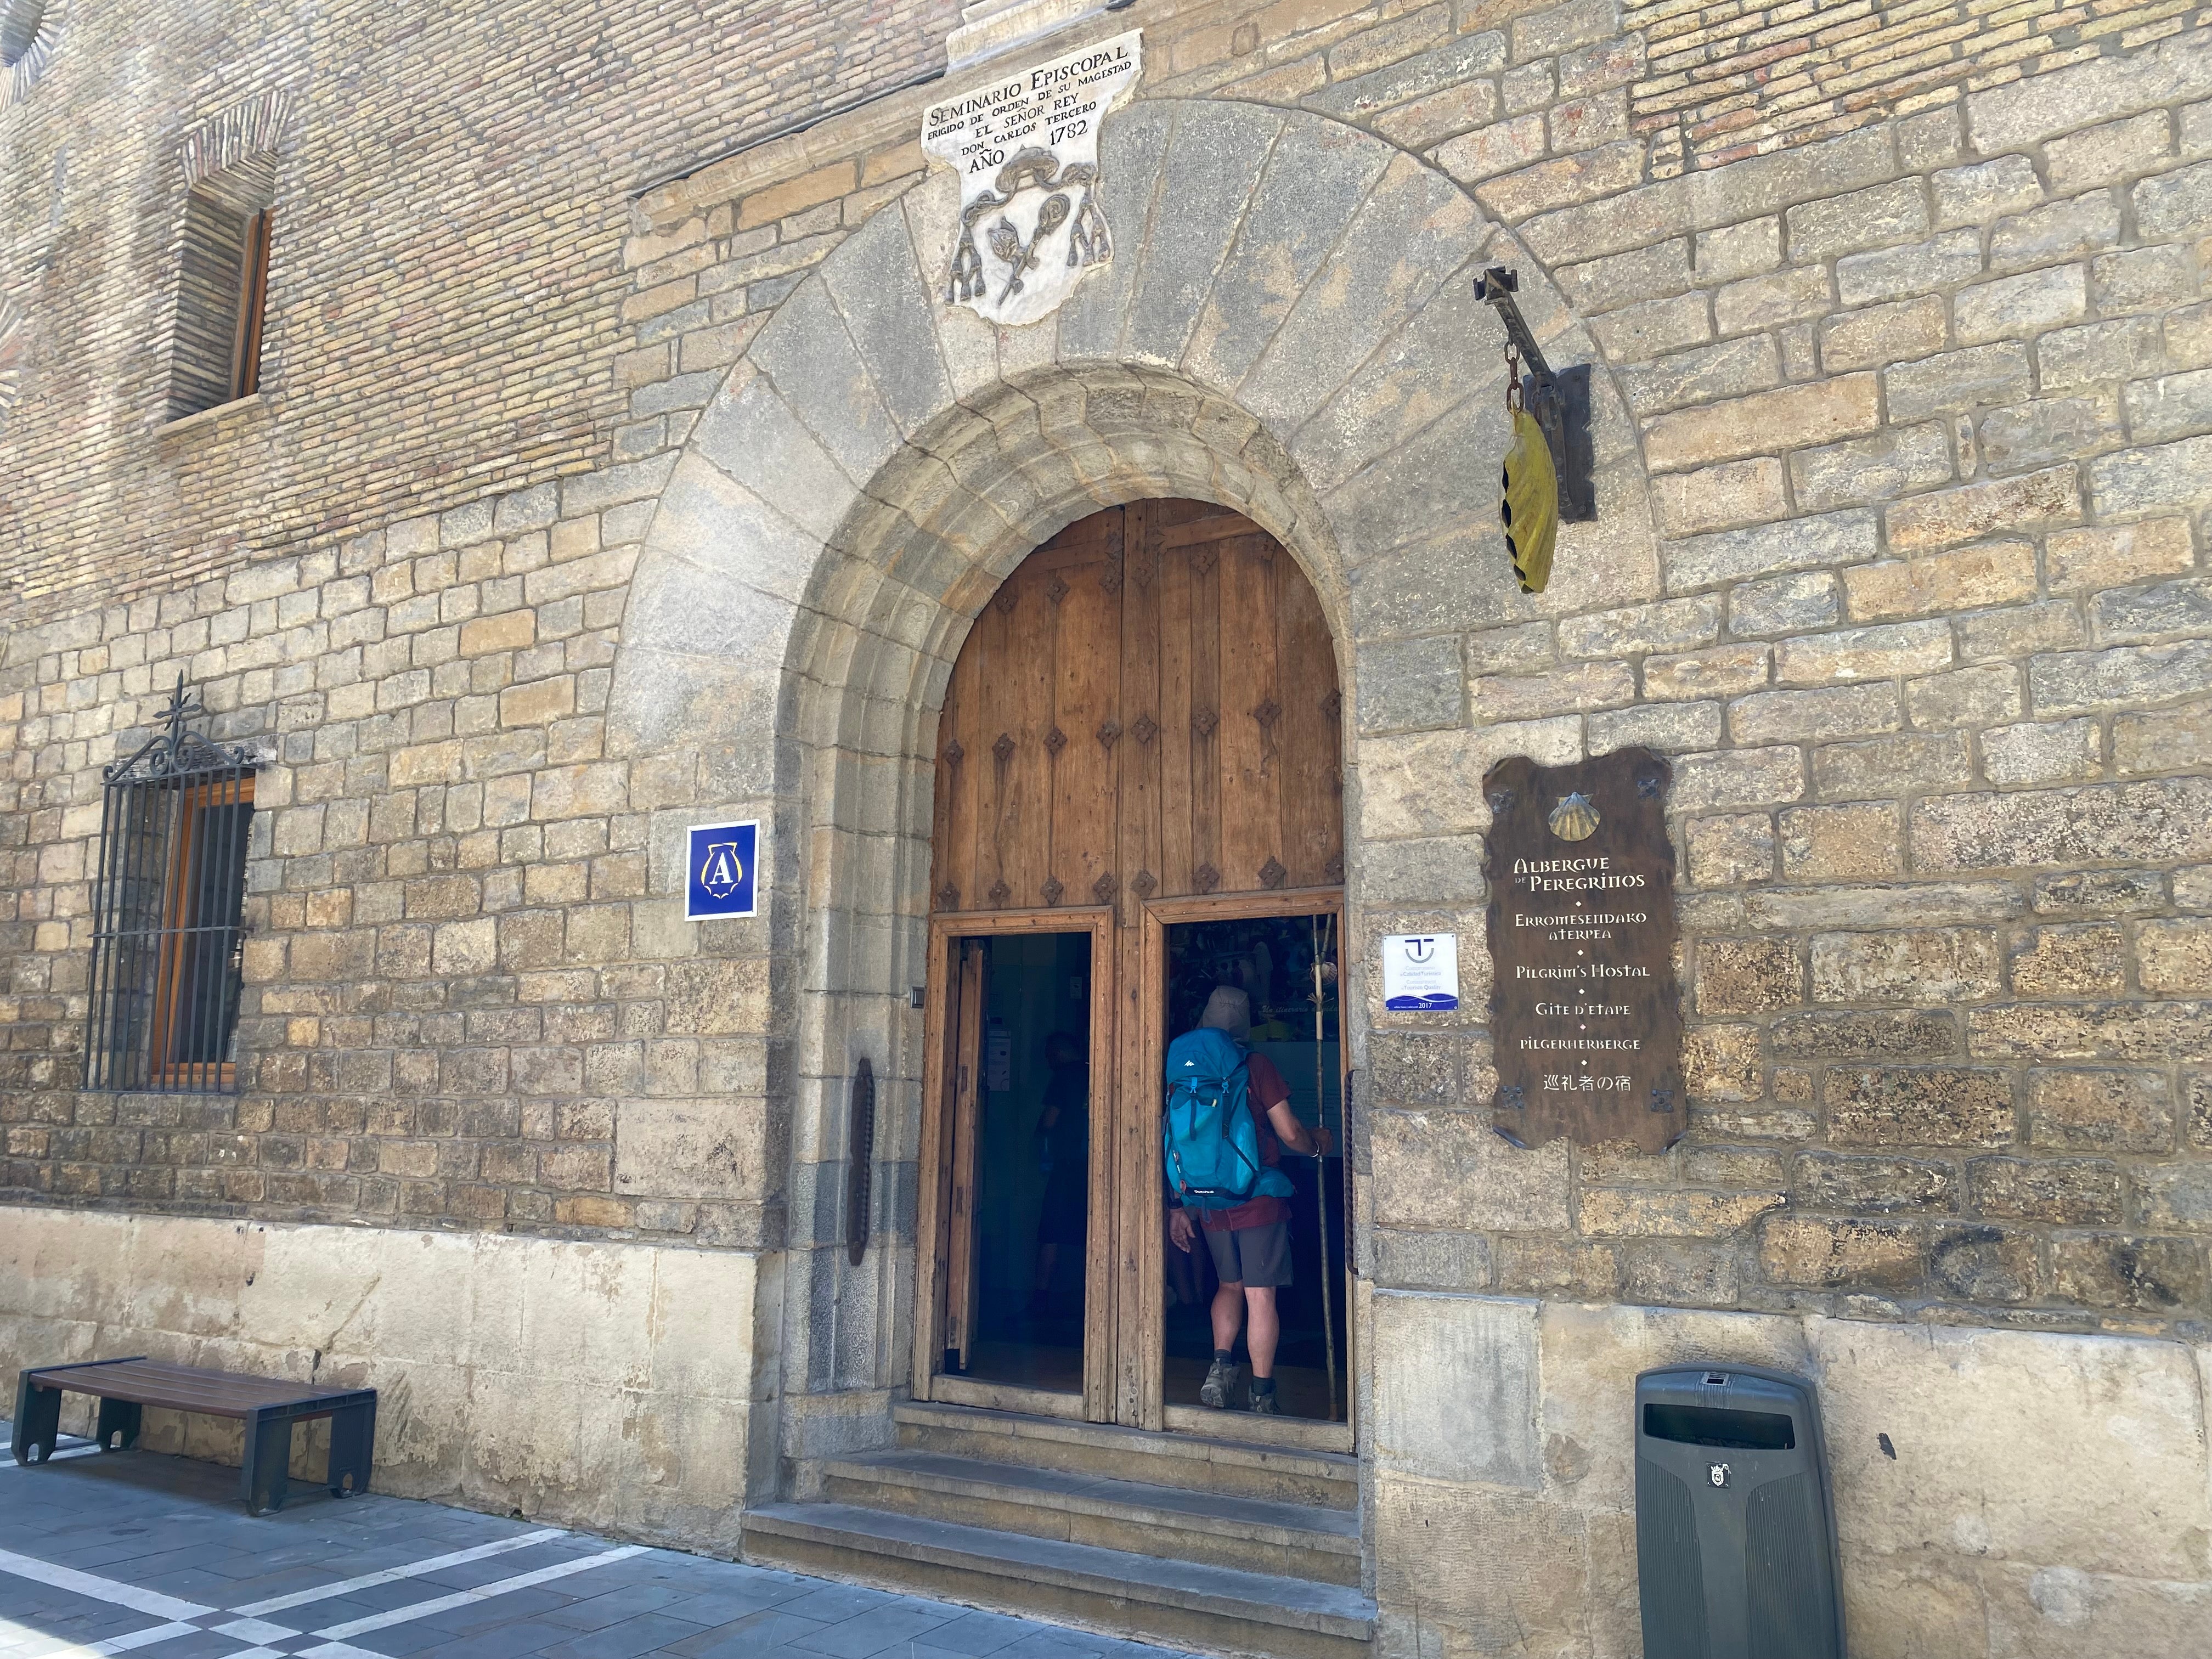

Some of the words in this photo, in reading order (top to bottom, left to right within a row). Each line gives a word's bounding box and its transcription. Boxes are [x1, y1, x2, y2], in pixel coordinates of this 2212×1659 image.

[929, 83, 1021, 126] SEMINARIO
[1031, 47, 1128, 91] EPISCOPAL
[928, 121, 964, 140] ERIGIDO
[970, 114, 984, 125] DE
[992, 98, 1029, 117] ORDEN
[1039, 89, 1052, 100] DE
[1058, 82, 1071, 92] SU
[1077, 61, 1131, 87] MAGESTAD
[975, 125, 993, 138] EL
[1004, 105, 1045, 128] SEÑOR
[1054, 93, 1080, 110] REY
[961, 141, 985, 156] DON
[994, 122, 1036, 143] CARLOS
[1045, 101, 1097, 126] TERCERO
[969, 148, 1005, 173] AÑO
[1050, 120, 1088, 146] 1782
[709, 852, 733, 884] A
[1514, 857, 1609, 874] ALBERGUE
[1515, 913, 1647, 927] ERROMESENDAKO
[1549, 929, 1611, 940] ATERPEA
[1591, 964, 1650, 978] HOSTAL
[1521, 1036, 1640, 1050] PILGERHERBERGE
[1544, 1074, 1631, 1091] 巡礼者の宿
